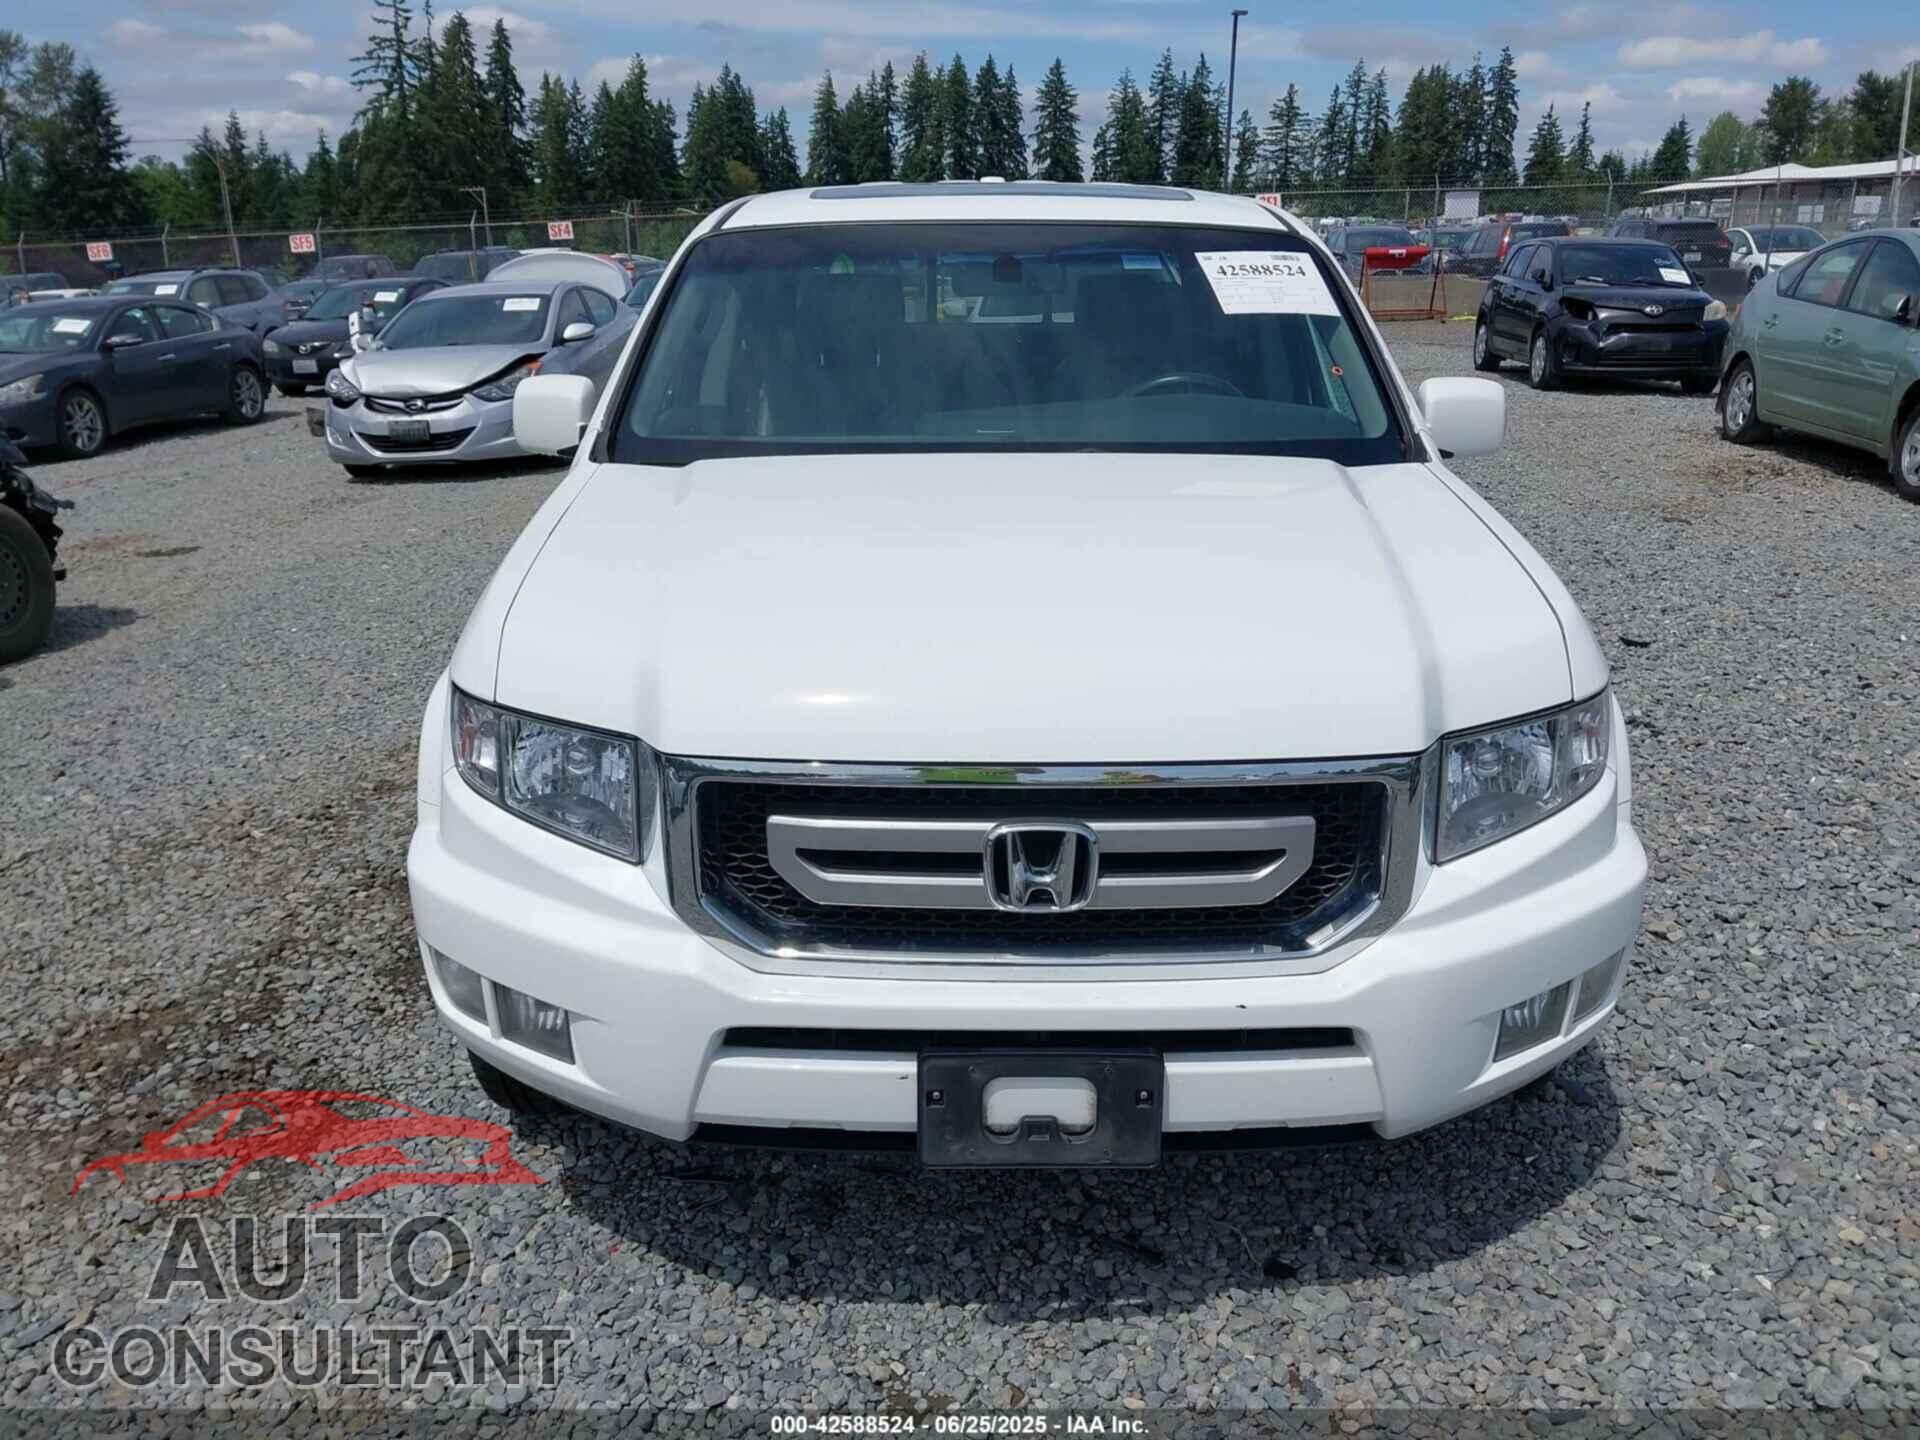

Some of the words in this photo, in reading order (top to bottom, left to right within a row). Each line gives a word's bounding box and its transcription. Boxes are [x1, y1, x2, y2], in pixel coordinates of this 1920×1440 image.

[551, 223, 571, 238] SF4
[291, 235, 313, 250] SF5
[1216, 263, 1307, 278] 42588524
